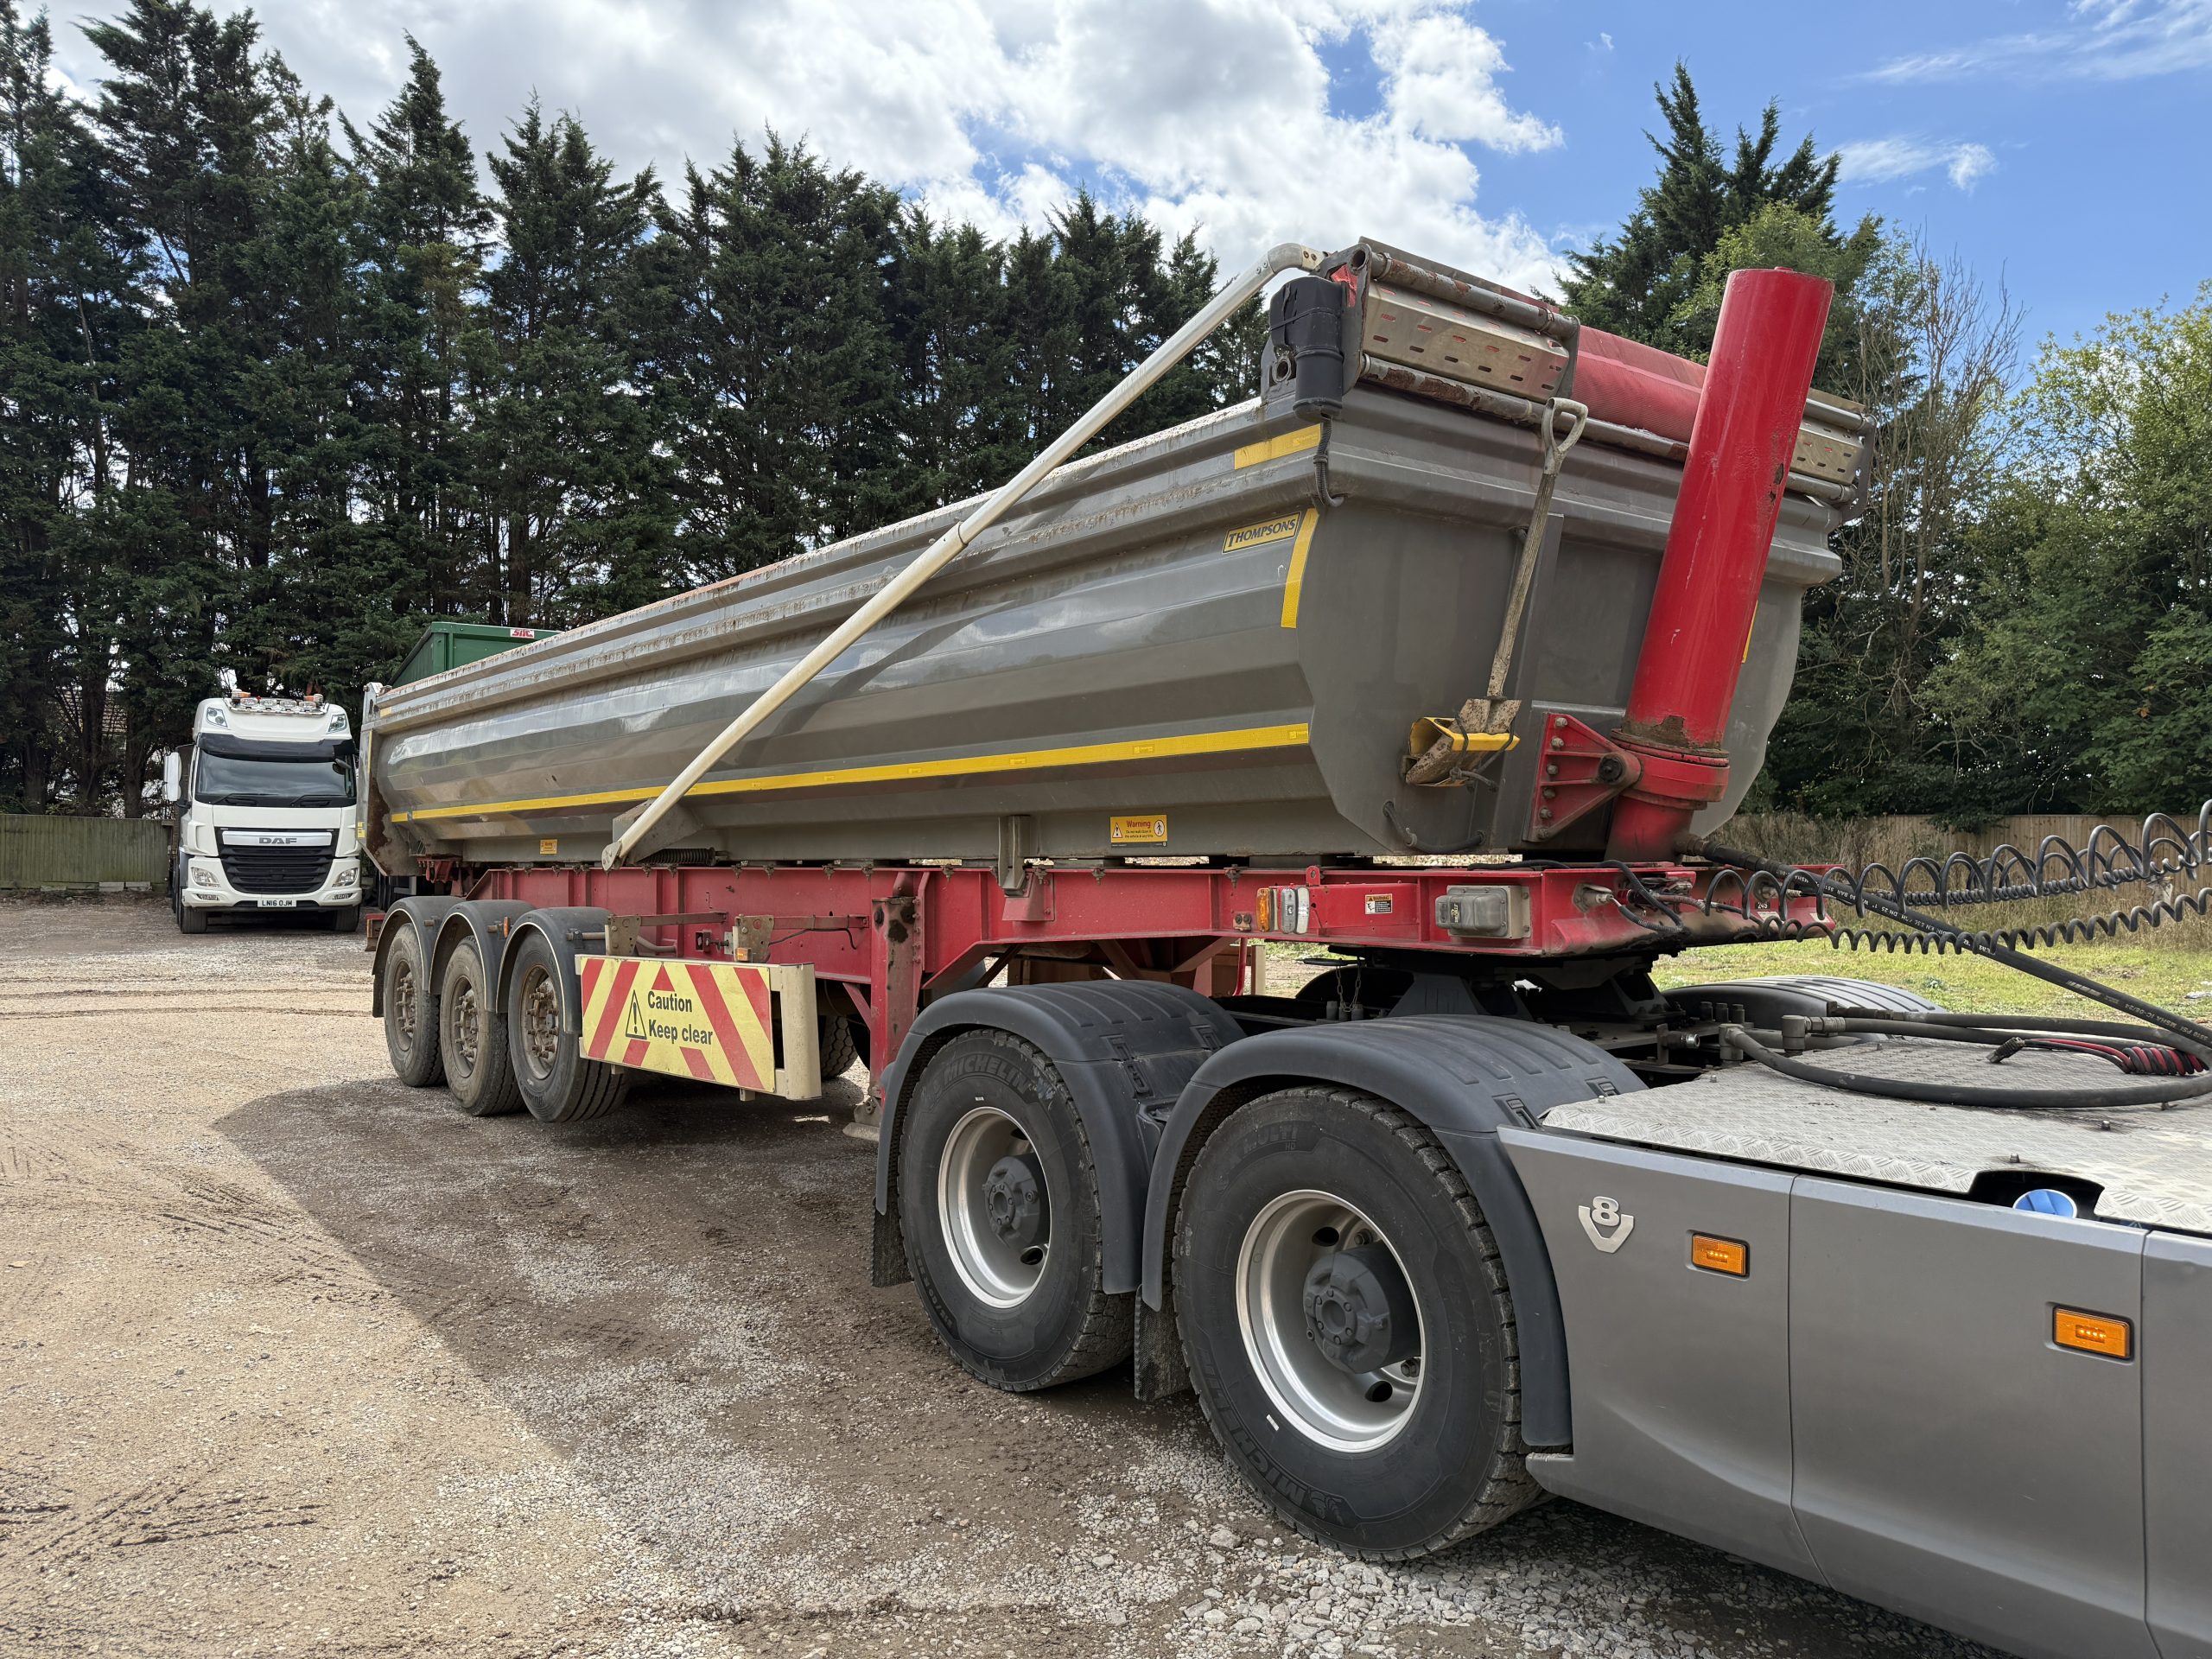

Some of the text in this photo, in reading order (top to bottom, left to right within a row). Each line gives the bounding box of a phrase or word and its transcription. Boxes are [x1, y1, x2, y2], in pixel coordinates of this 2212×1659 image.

[1228, 519, 1296, 548] THOMPSONS
[1127, 820, 1151, 829] Warning
[647, 990, 692, 1013] Caution
[649, 1019, 713, 1045] Keep clear
[944, 1053, 1030, 1095] MICHELIN
